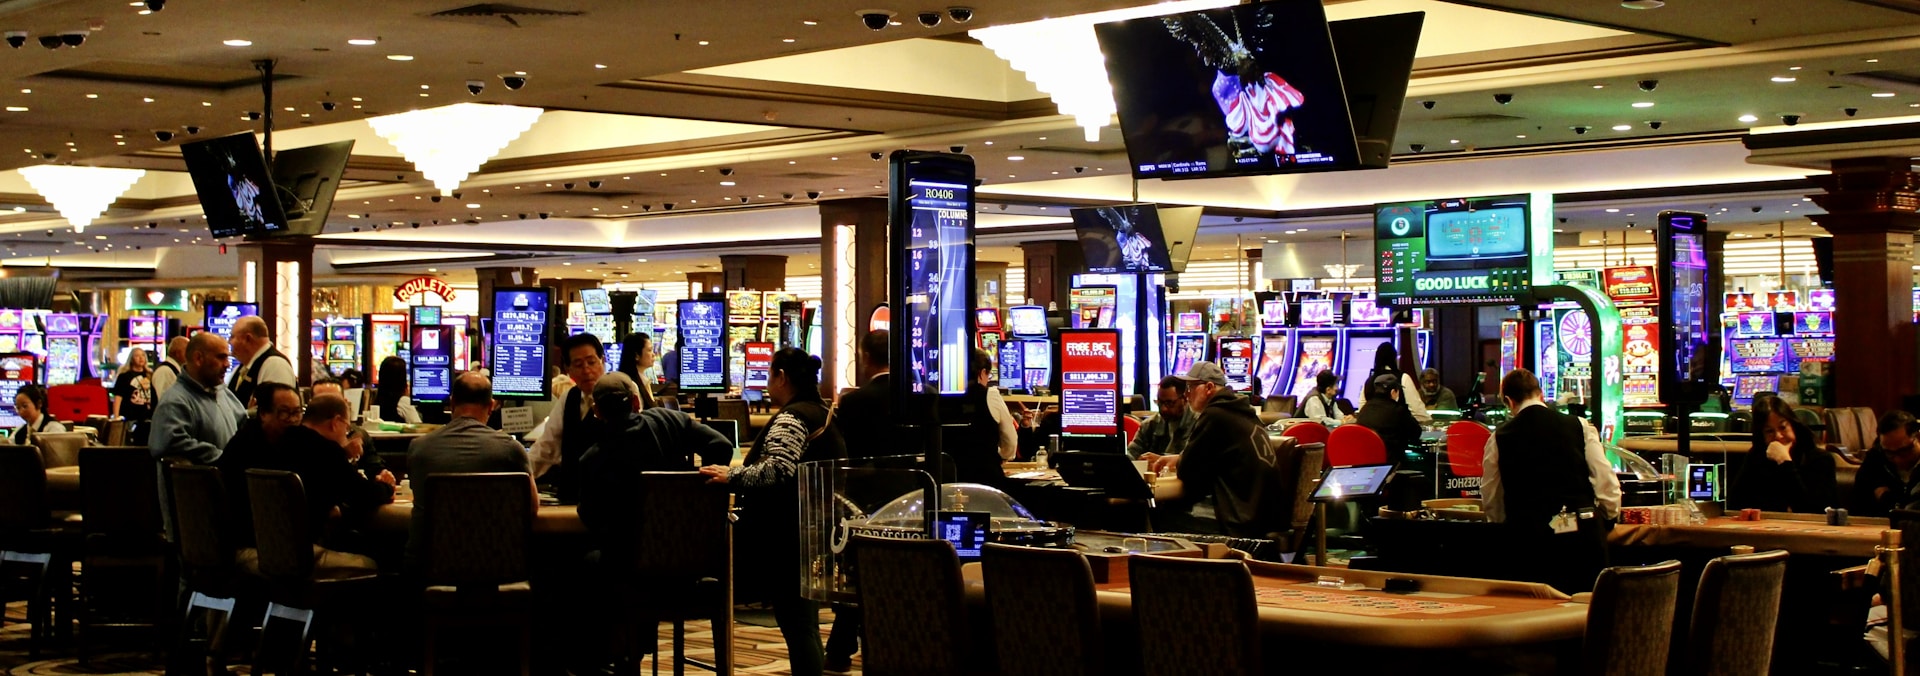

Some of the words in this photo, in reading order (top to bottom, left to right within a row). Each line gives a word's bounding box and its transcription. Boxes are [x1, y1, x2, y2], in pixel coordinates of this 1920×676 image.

[925, 188, 953, 199] RO406
[912, 228, 922, 237] 12
[912, 250, 922, 259] 16
[914, 261, 920, 270] 3
[1415, 278, 1452, 290] GOOD
[1455, 276, 1489, 289] LUCK
[398, 278, 456, 302] ROULETTE
[914, 317, 920, 325] 7
[912, 328, 922, 336] 23
[912, 339, 922, 348] 36
[1066, 343, 1090, 352] FREE
[1092, 343, 1111, 351] BET
[929, 350, 938, 359] 17
[912, 383, 922, 392] 16
